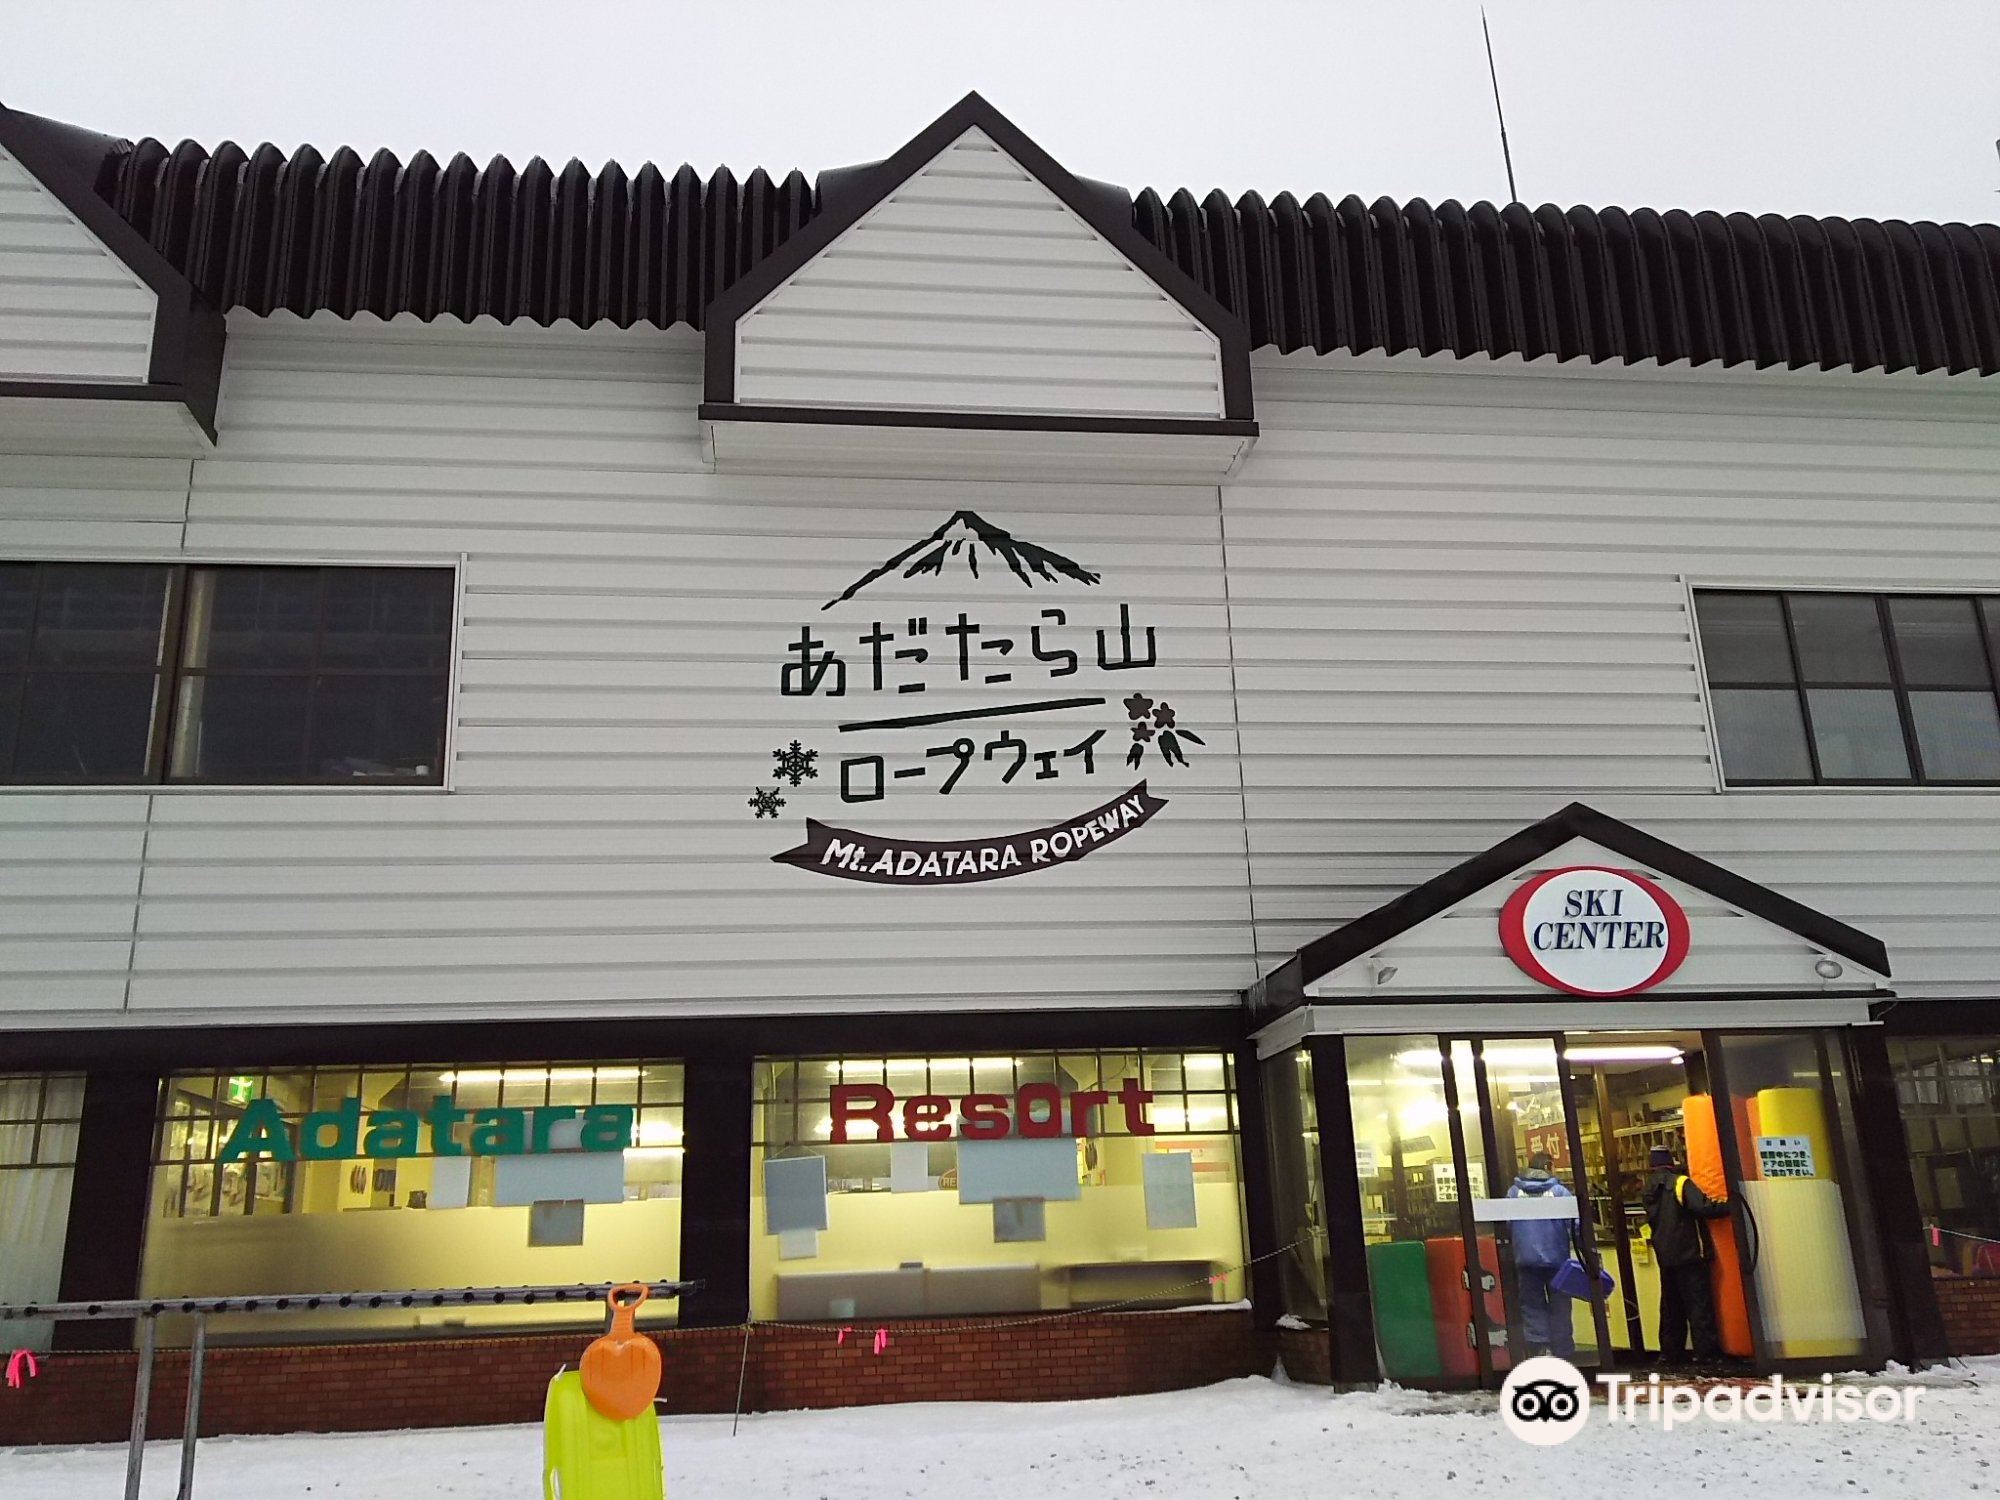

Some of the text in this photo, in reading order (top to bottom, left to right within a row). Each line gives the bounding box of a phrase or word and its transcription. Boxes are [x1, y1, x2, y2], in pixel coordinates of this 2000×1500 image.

[781, 604, 1156, 696] あだたら山
[841, 730, 1107, 803] ロープウェイ
[1030, 794, 1146, 864] ROPEWAY
[1534, 921, 1665, 950] CENTER
[1565, 889, 1623, 917] SKI
[217, 1095, 633, 1163] Adatara
